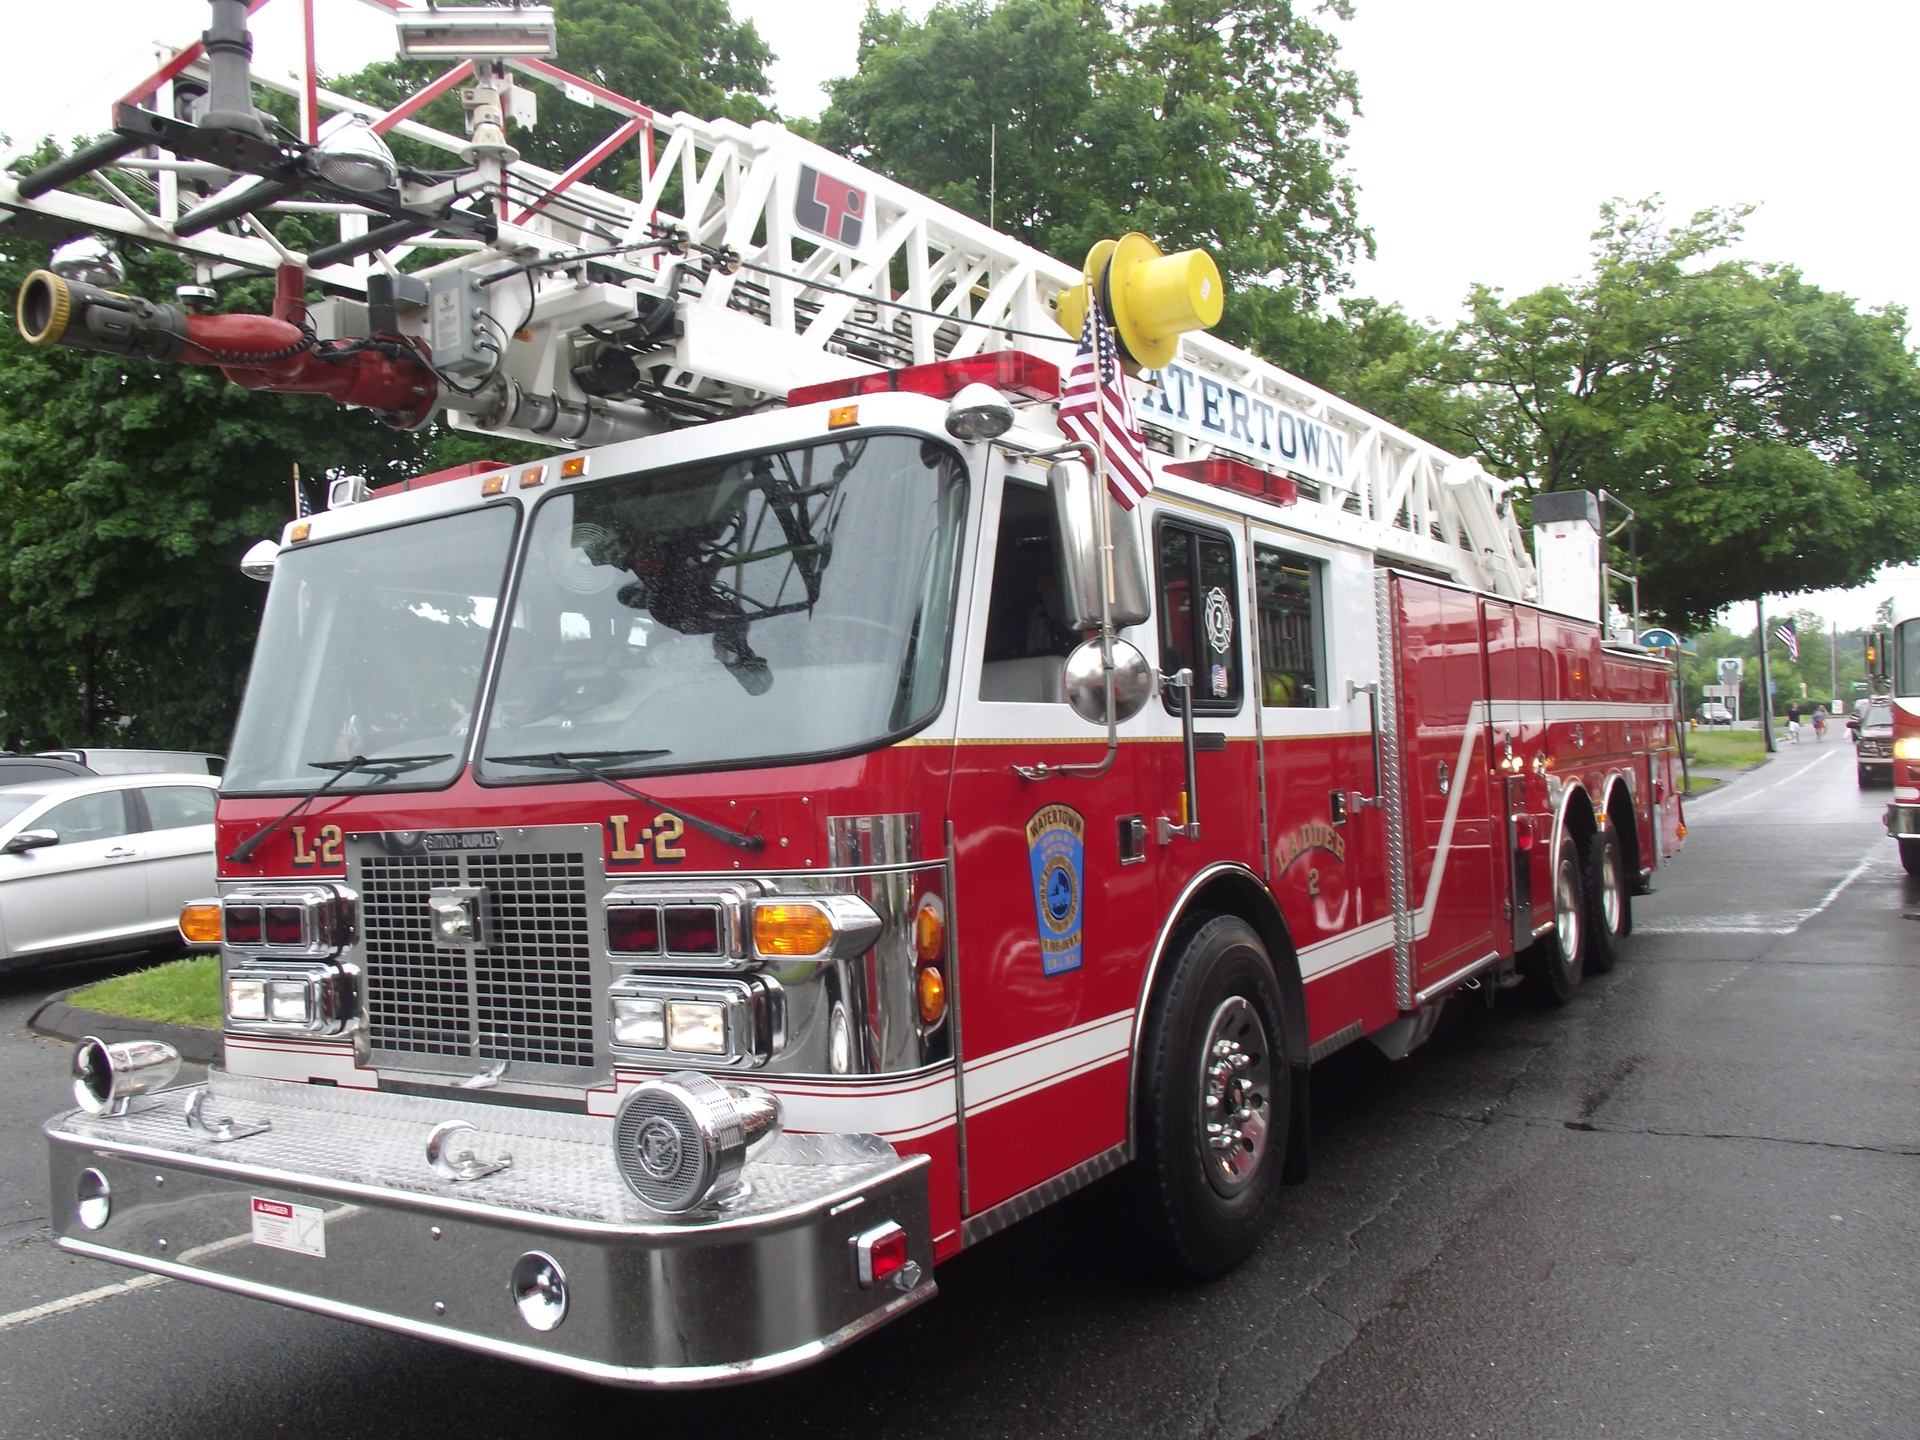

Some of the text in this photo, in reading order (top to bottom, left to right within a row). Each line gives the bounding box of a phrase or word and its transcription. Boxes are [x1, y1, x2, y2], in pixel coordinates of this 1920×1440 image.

[1132, 364, 1344, 477] ATERTOWN
[1215, 611, 1222, 629] 2
[1030, 809, 1081, 838] WATERTOWN
[1276, 823, 1345, 876] LADDER
[1308, 868, 1320, 896] 2
